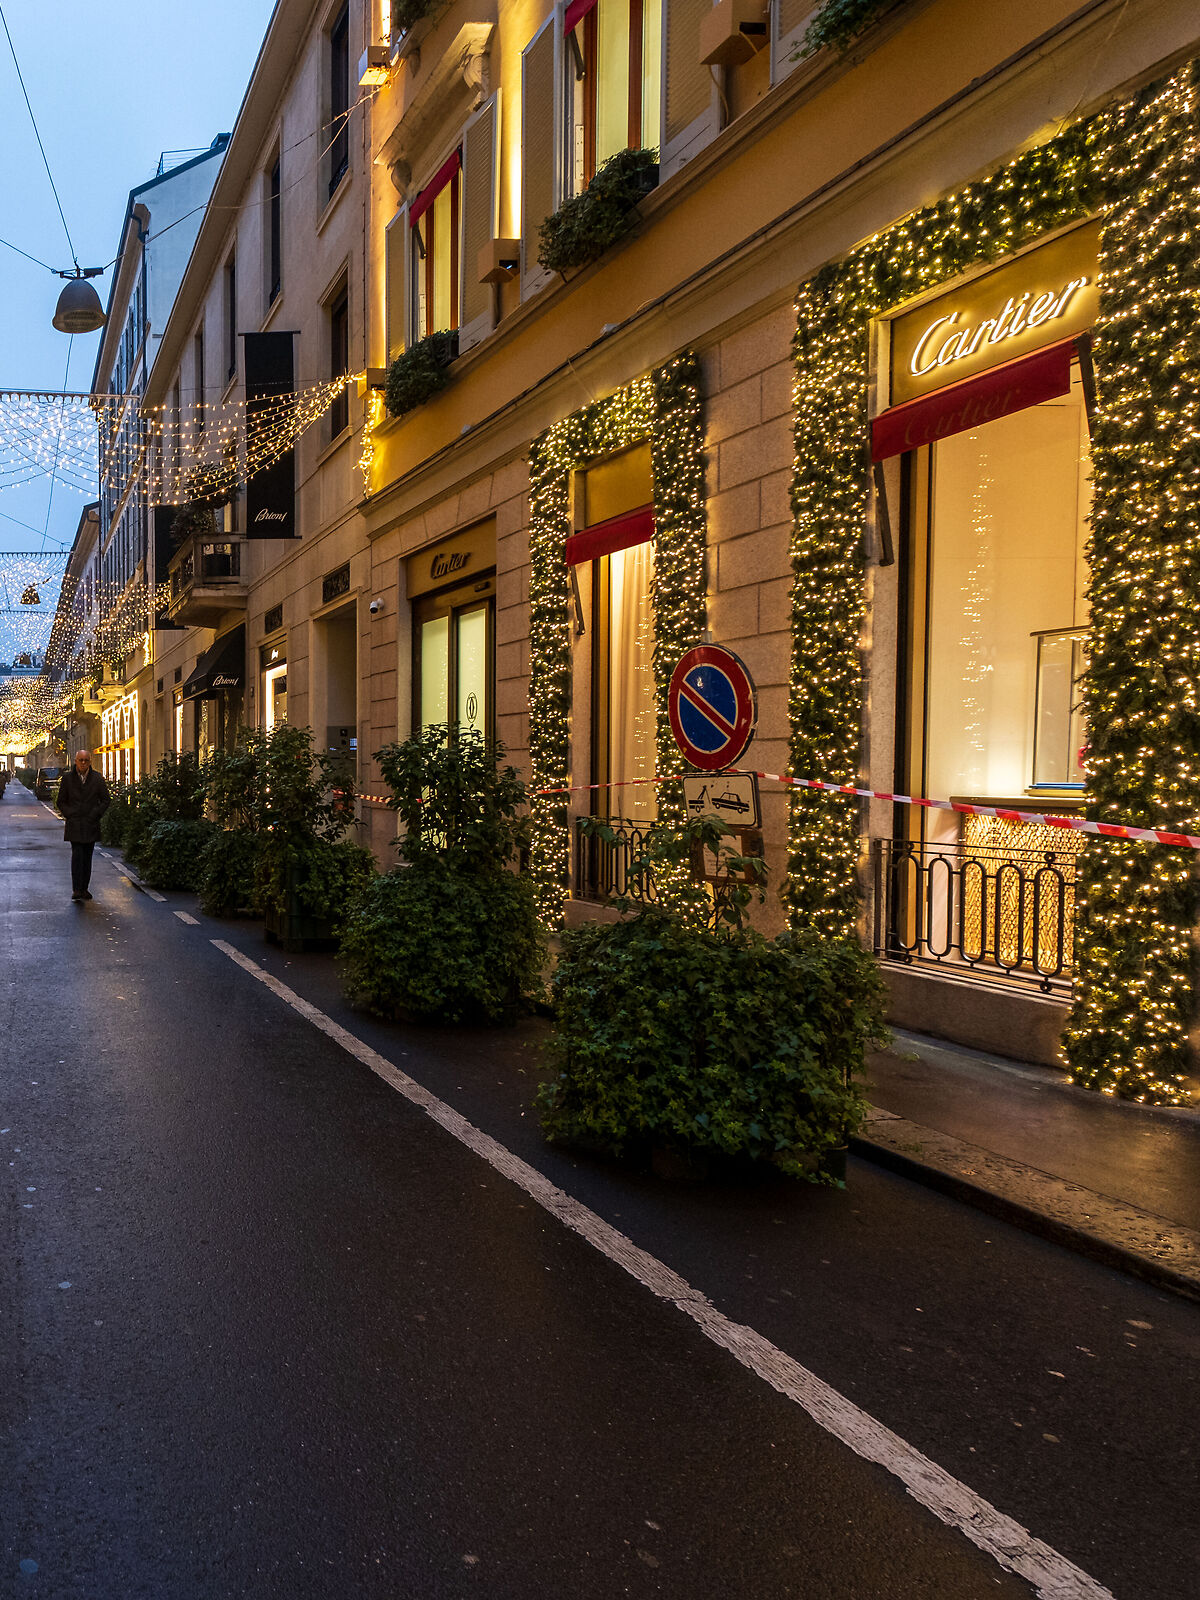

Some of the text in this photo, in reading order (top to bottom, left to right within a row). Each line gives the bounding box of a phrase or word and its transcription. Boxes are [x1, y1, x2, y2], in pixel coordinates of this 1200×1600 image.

[910, 276, 1088, 377] Cartier
[254, 508, 288, 522] Brioni
[430, 552, 472, 579] Cartier
